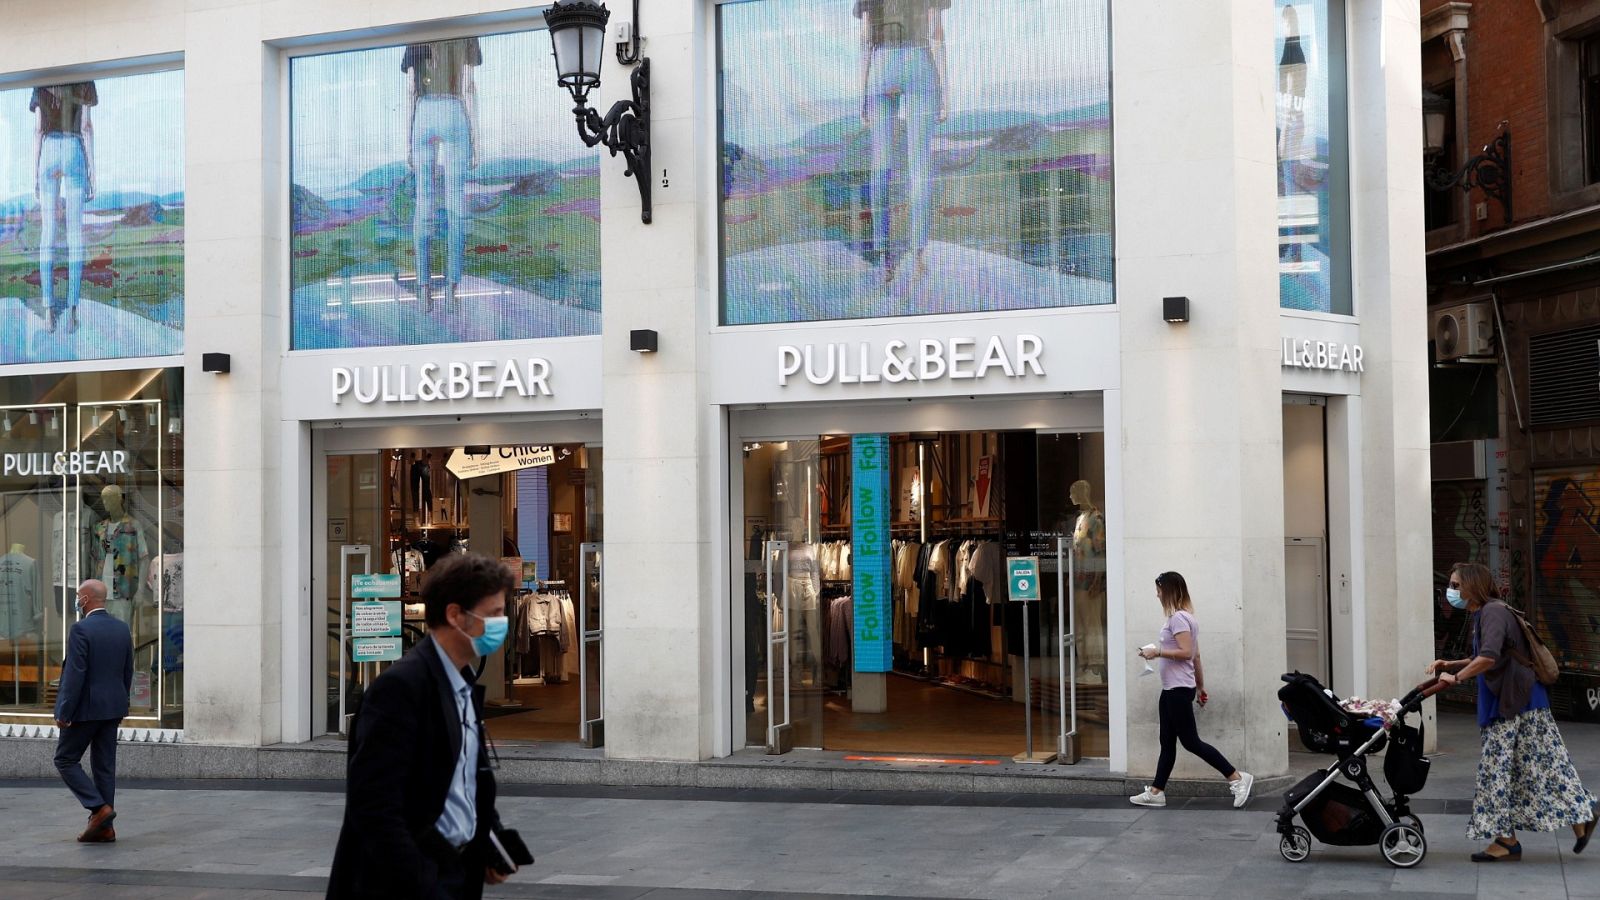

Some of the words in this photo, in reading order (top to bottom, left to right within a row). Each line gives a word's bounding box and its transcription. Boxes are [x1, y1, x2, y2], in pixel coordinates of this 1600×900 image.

[331, 357, 554, 405] PULL&BEAR
[776, 334, 1047, 387] PULL&BEAR
[3, 450, 127, 476] PULL&BEAR
[517, 454, 553, 467] Women
[857, 487, 879, 557] Follow
[861, 572, 880, 641] Follow
